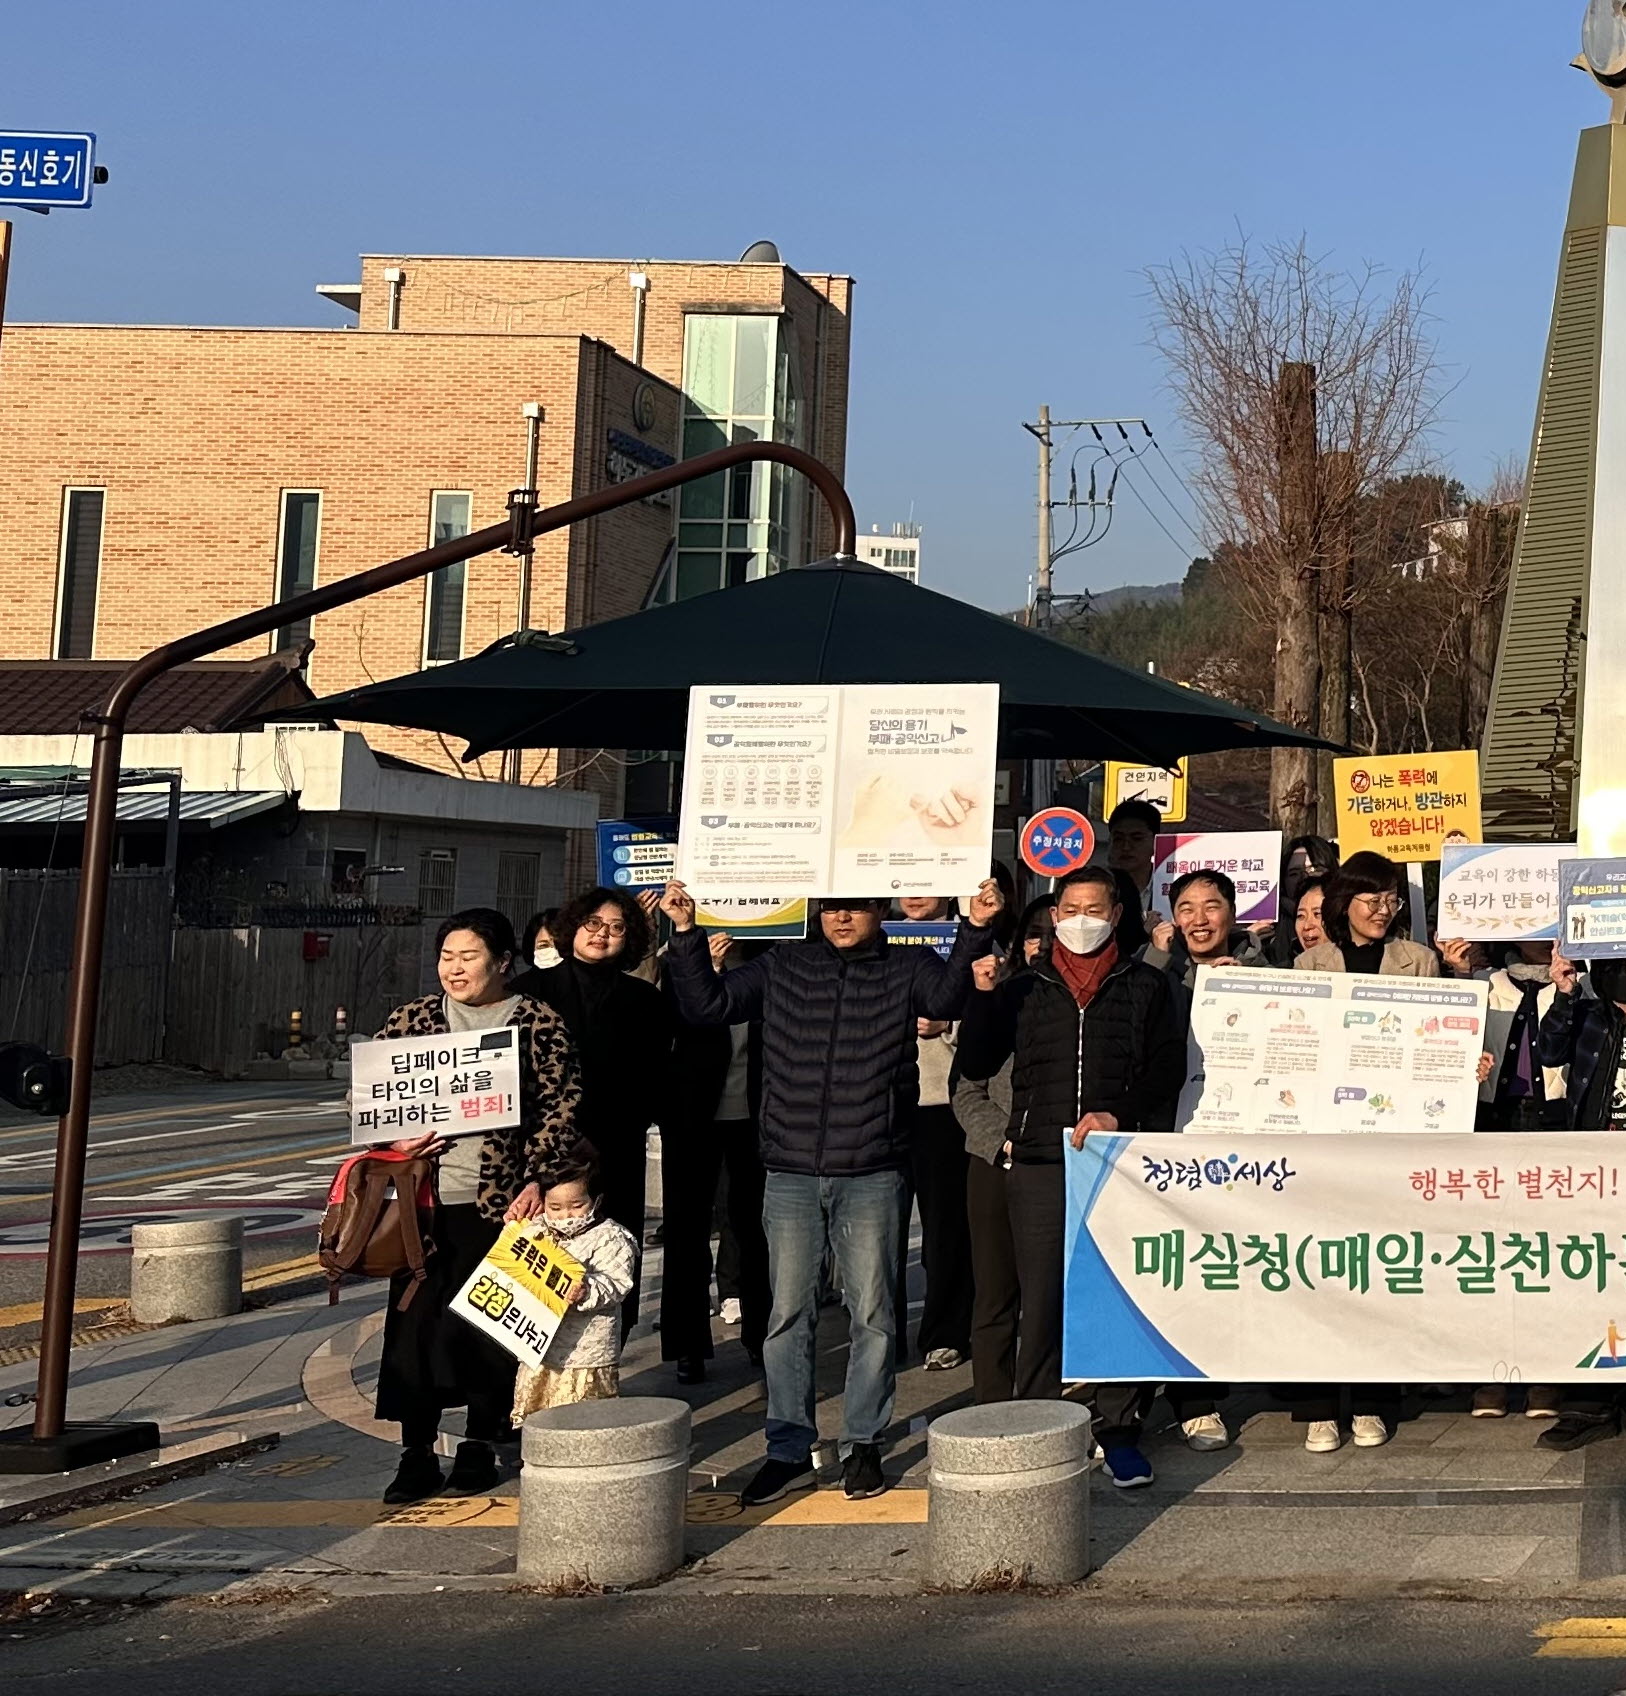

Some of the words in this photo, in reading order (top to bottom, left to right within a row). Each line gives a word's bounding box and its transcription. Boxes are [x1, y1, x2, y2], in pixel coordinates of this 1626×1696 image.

[0, 148, 81, 190] 동신호기
[1372, 773, 1395, 789] 나는
[1397, 768, 1438, 788] 폭력에
[1415, 791, 1467, 811] 방관하지
[1370, 815, 1445, 837] 않겠습니다!
[1241, 858, 1264, 872] 학교
[1458, 868, 1498, 883] 교육이
[1504, 867, 1531, 883] 강한
[1235, 880, 1270, 894] 동교육
[1444, 892, 1496, 910] 우리가
[391, 1047, 482, 1075] 딥페이크
[372, 1076, 439, 1101] 타인의
[450, 1070, 494, 1095] 삶을
[358, 1102, 452, 1129] 파괴하는
[460, 1093, 513, 1119] 범죄!
[1234, 1157, 1296, 1192] 세상
[1408, 1167, 1504, 1199] 행복한
[1517, 1165, 1619, 1199] 별천지!
[510, 1236, 549, 1279] 폭력은
